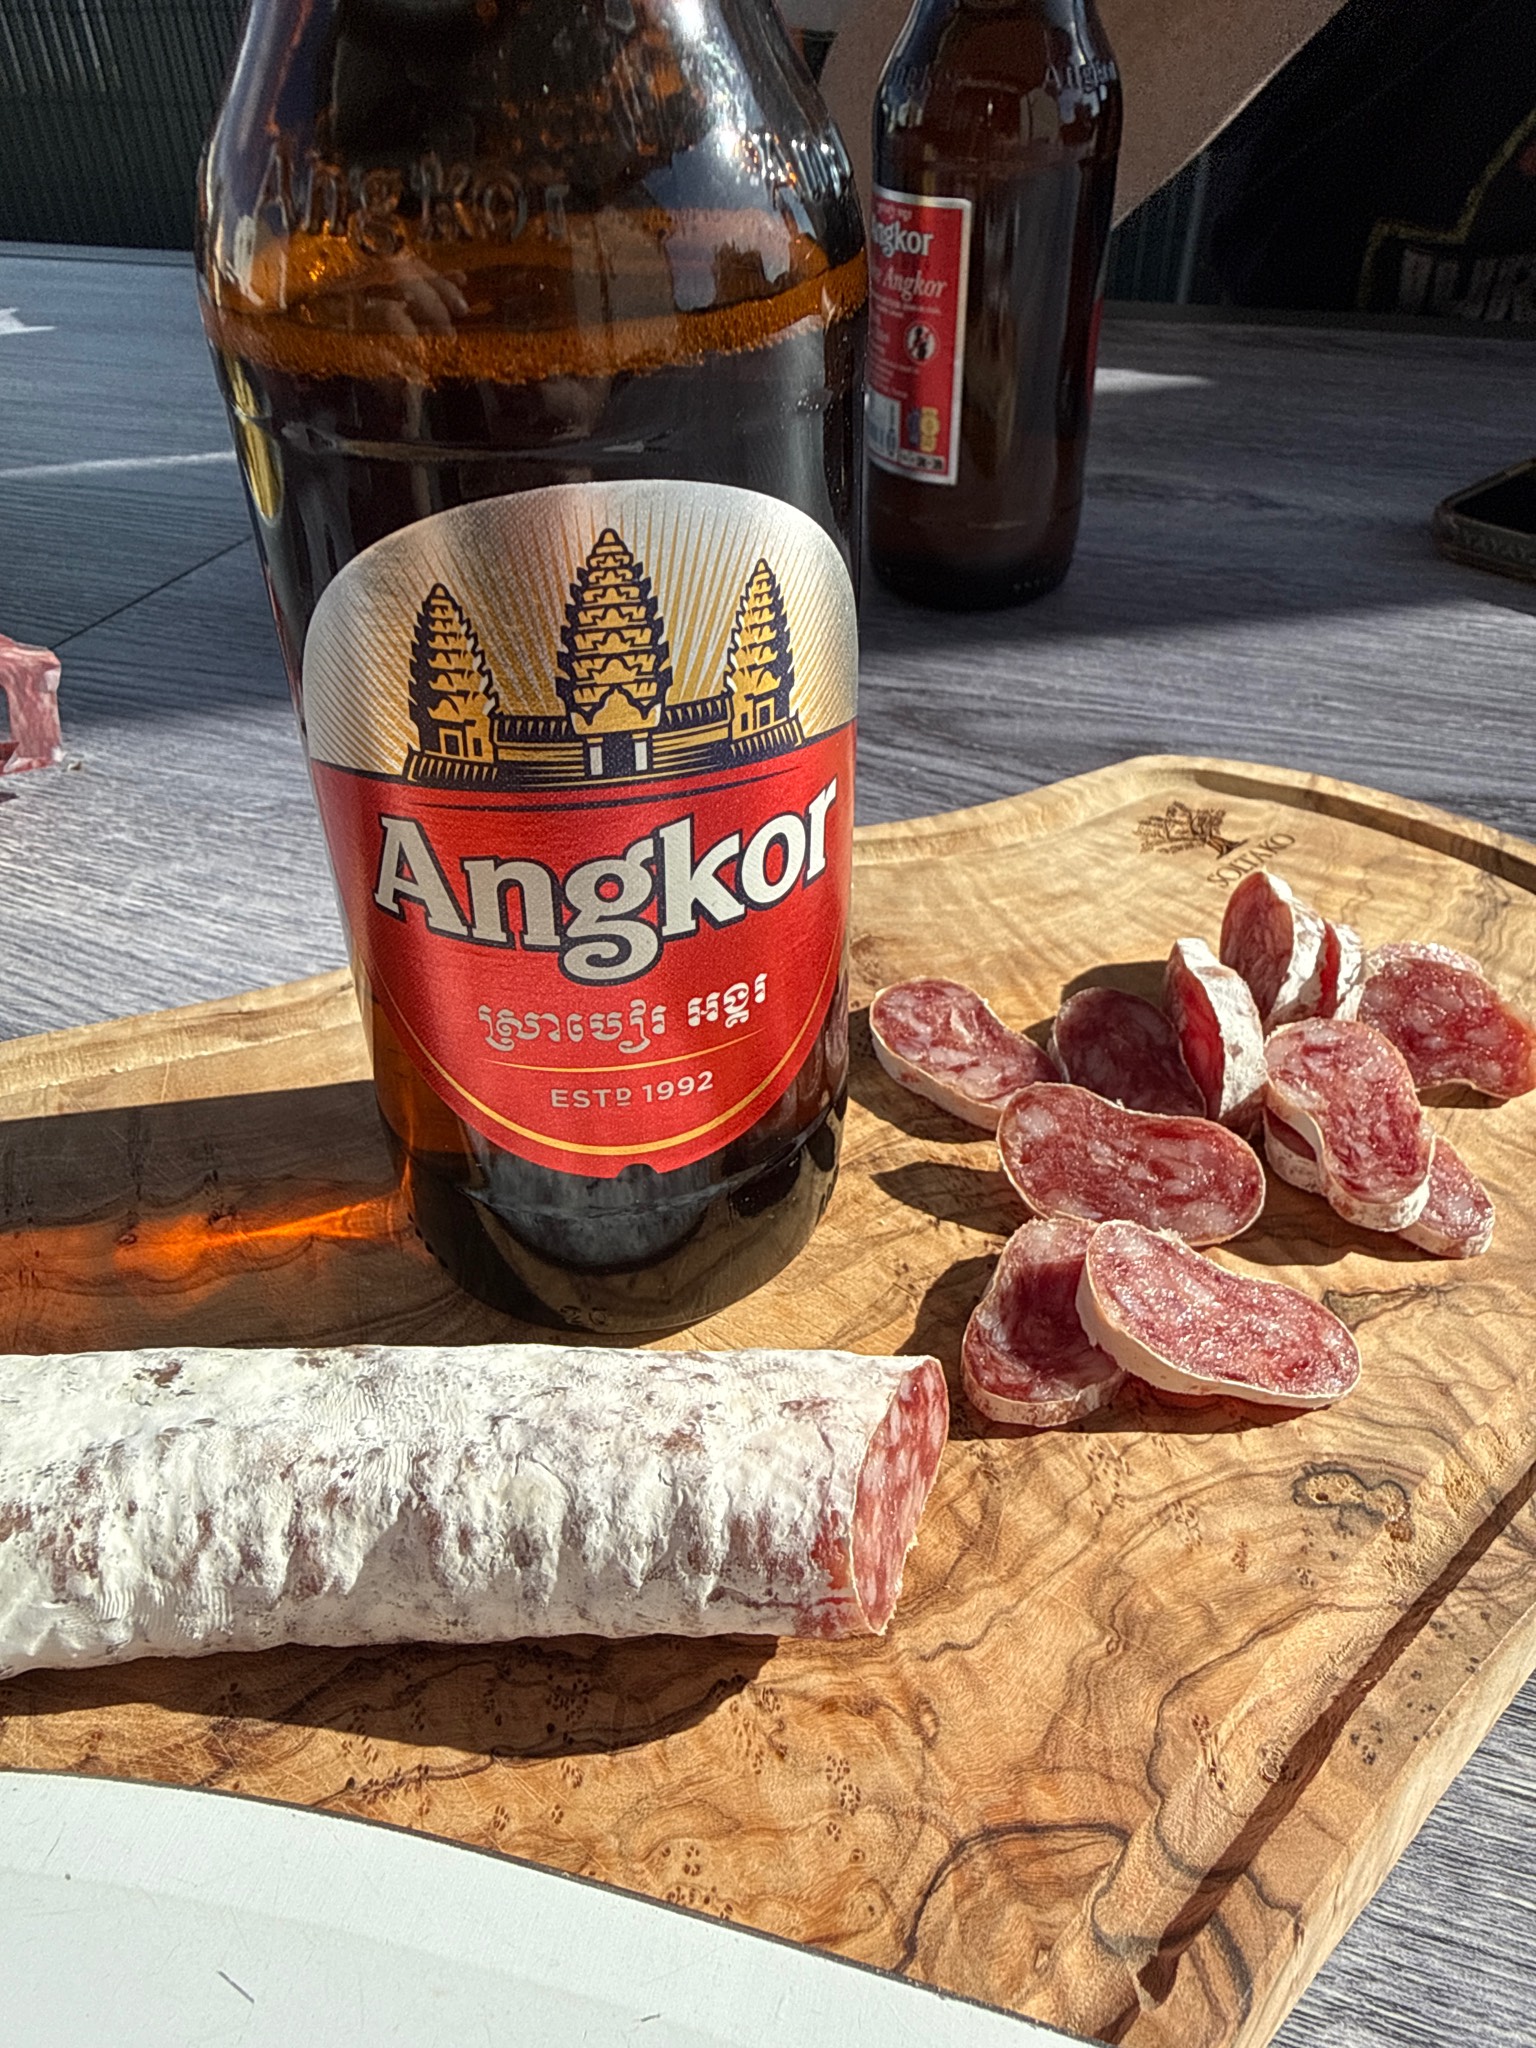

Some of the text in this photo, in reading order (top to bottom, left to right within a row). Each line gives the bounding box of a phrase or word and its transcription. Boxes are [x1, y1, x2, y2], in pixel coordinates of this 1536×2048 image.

[882, 263, 947, 302] Angkor
[371, 775, 839, 987] Angkor
[478, 972, 768, 1054] ស្រាបៀរ អង្គរ
[642, 1070, 714, 1104] 1992
